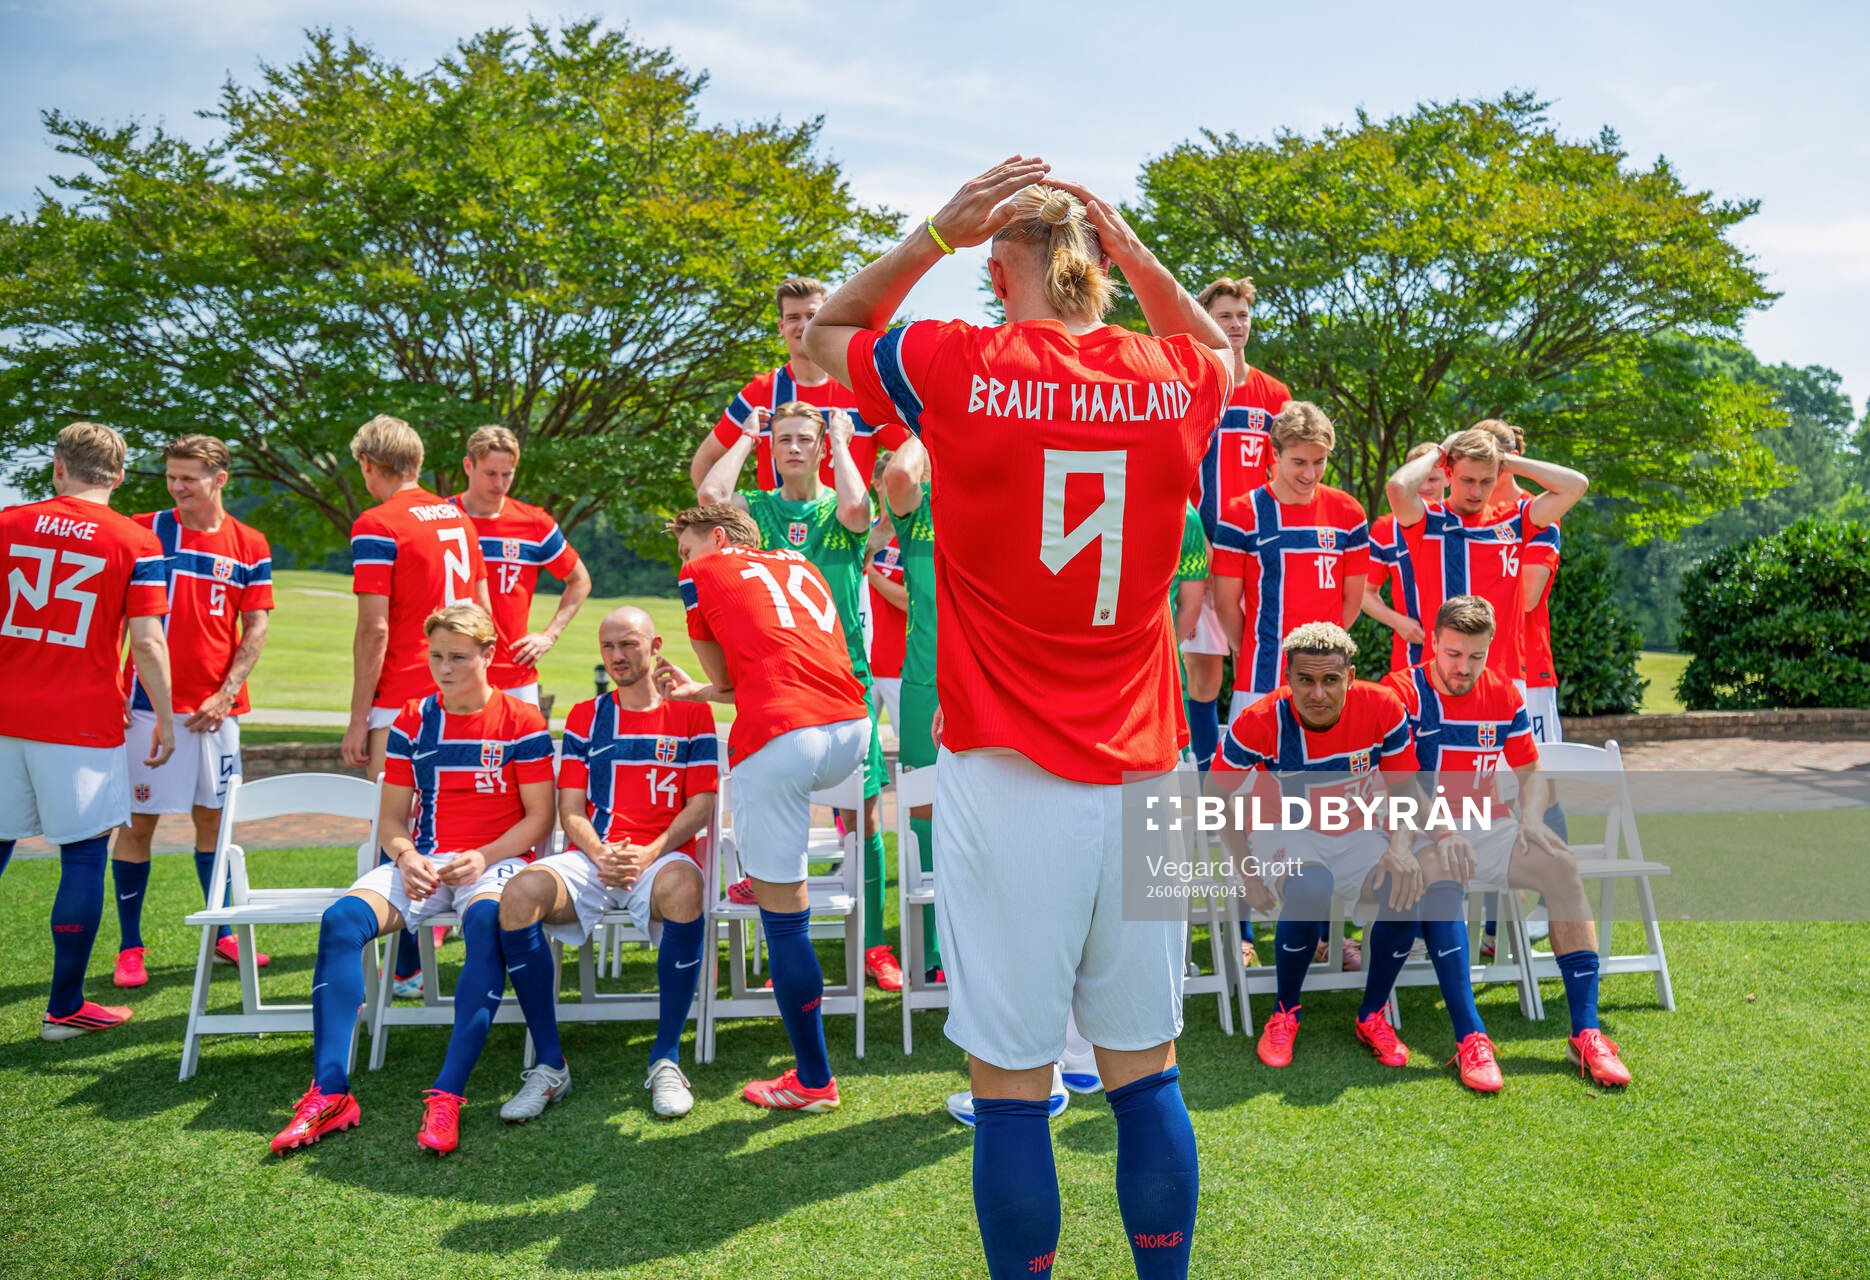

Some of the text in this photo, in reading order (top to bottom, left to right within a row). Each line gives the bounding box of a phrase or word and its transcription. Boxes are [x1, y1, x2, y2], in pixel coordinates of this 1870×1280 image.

[968, 374, 1191, 422] BRAUT HAALAND
[34, 514, 99, 541] HAUGE
[1040, 448, 1128, 626] 9
[437, 526, 473, 608] 2
[497, 564, 522, 593] 17
[1314, 555, 1337, 589] 18
[1498, 544, 1520, 577] 16
[0, 543, 107, 648] 23
[209, 584, 226, 616] 5
[740, 561, 837, 634] 10
[1529, 716, 1545, 743] 9
[646, 767, 678, 808] 14
